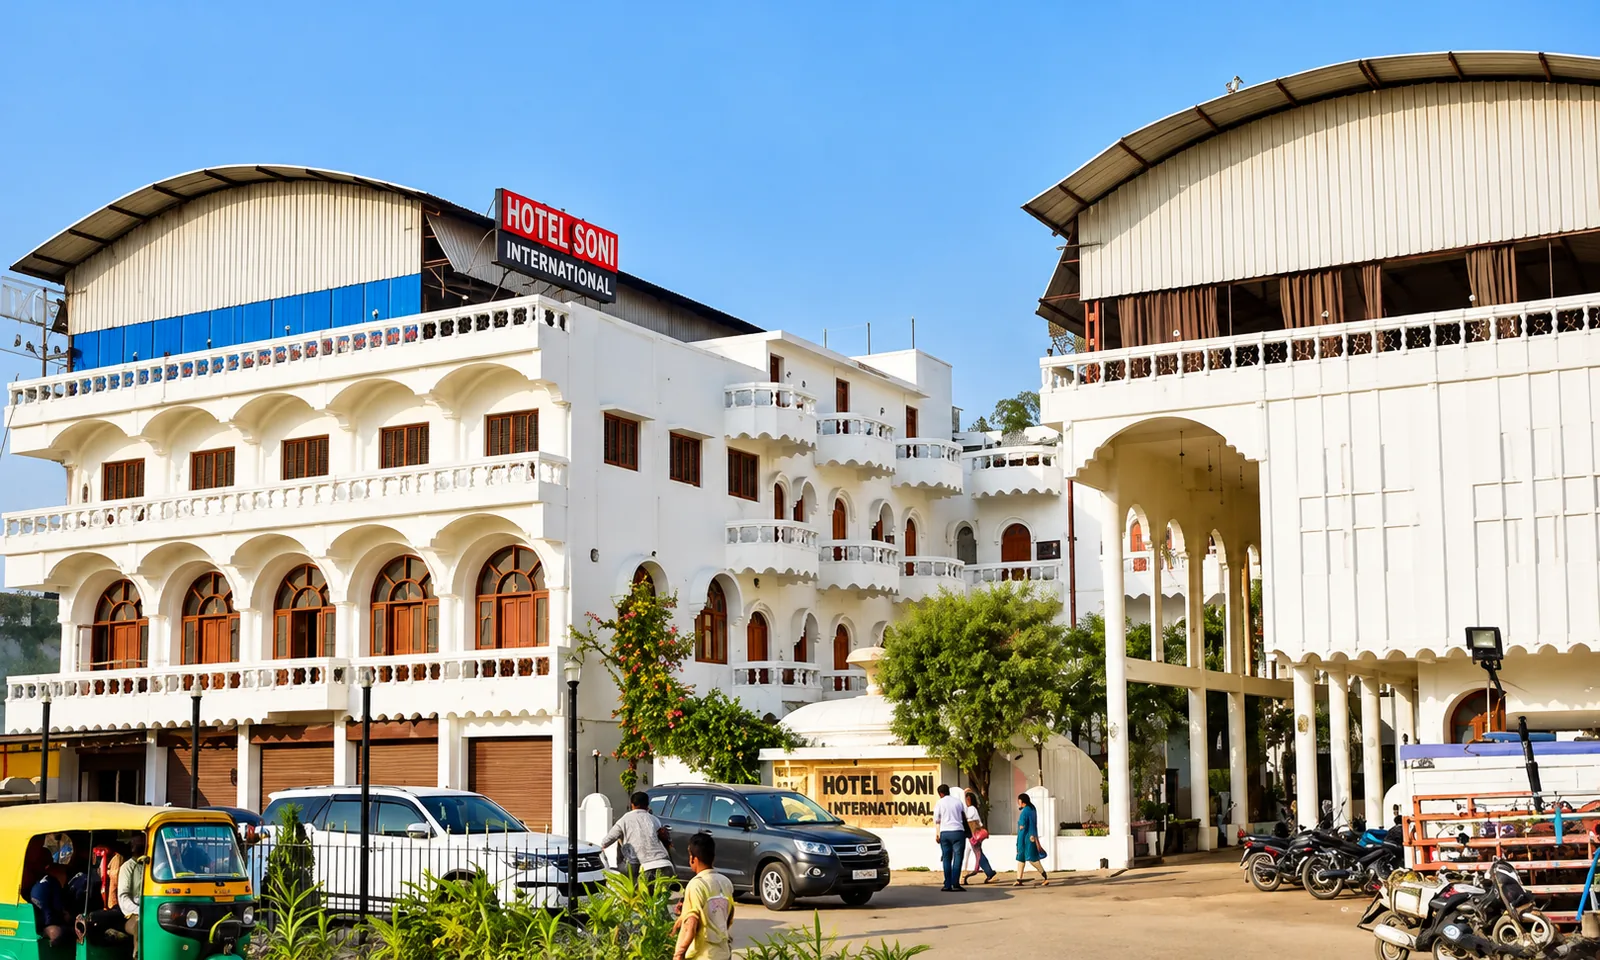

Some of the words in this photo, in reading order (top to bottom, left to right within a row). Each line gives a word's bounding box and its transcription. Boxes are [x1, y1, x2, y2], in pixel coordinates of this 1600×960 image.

[507, 196, 569, 249] HOTEL
[573, 223, 615, 267] SONI
[506, 240, 612, 296] INTERNATIONAL
[823, 775, 884, 796] HOTEL
[890, 774, 935, 796] SONI
[827, 801, 934, 816] INTERNATIONAL
